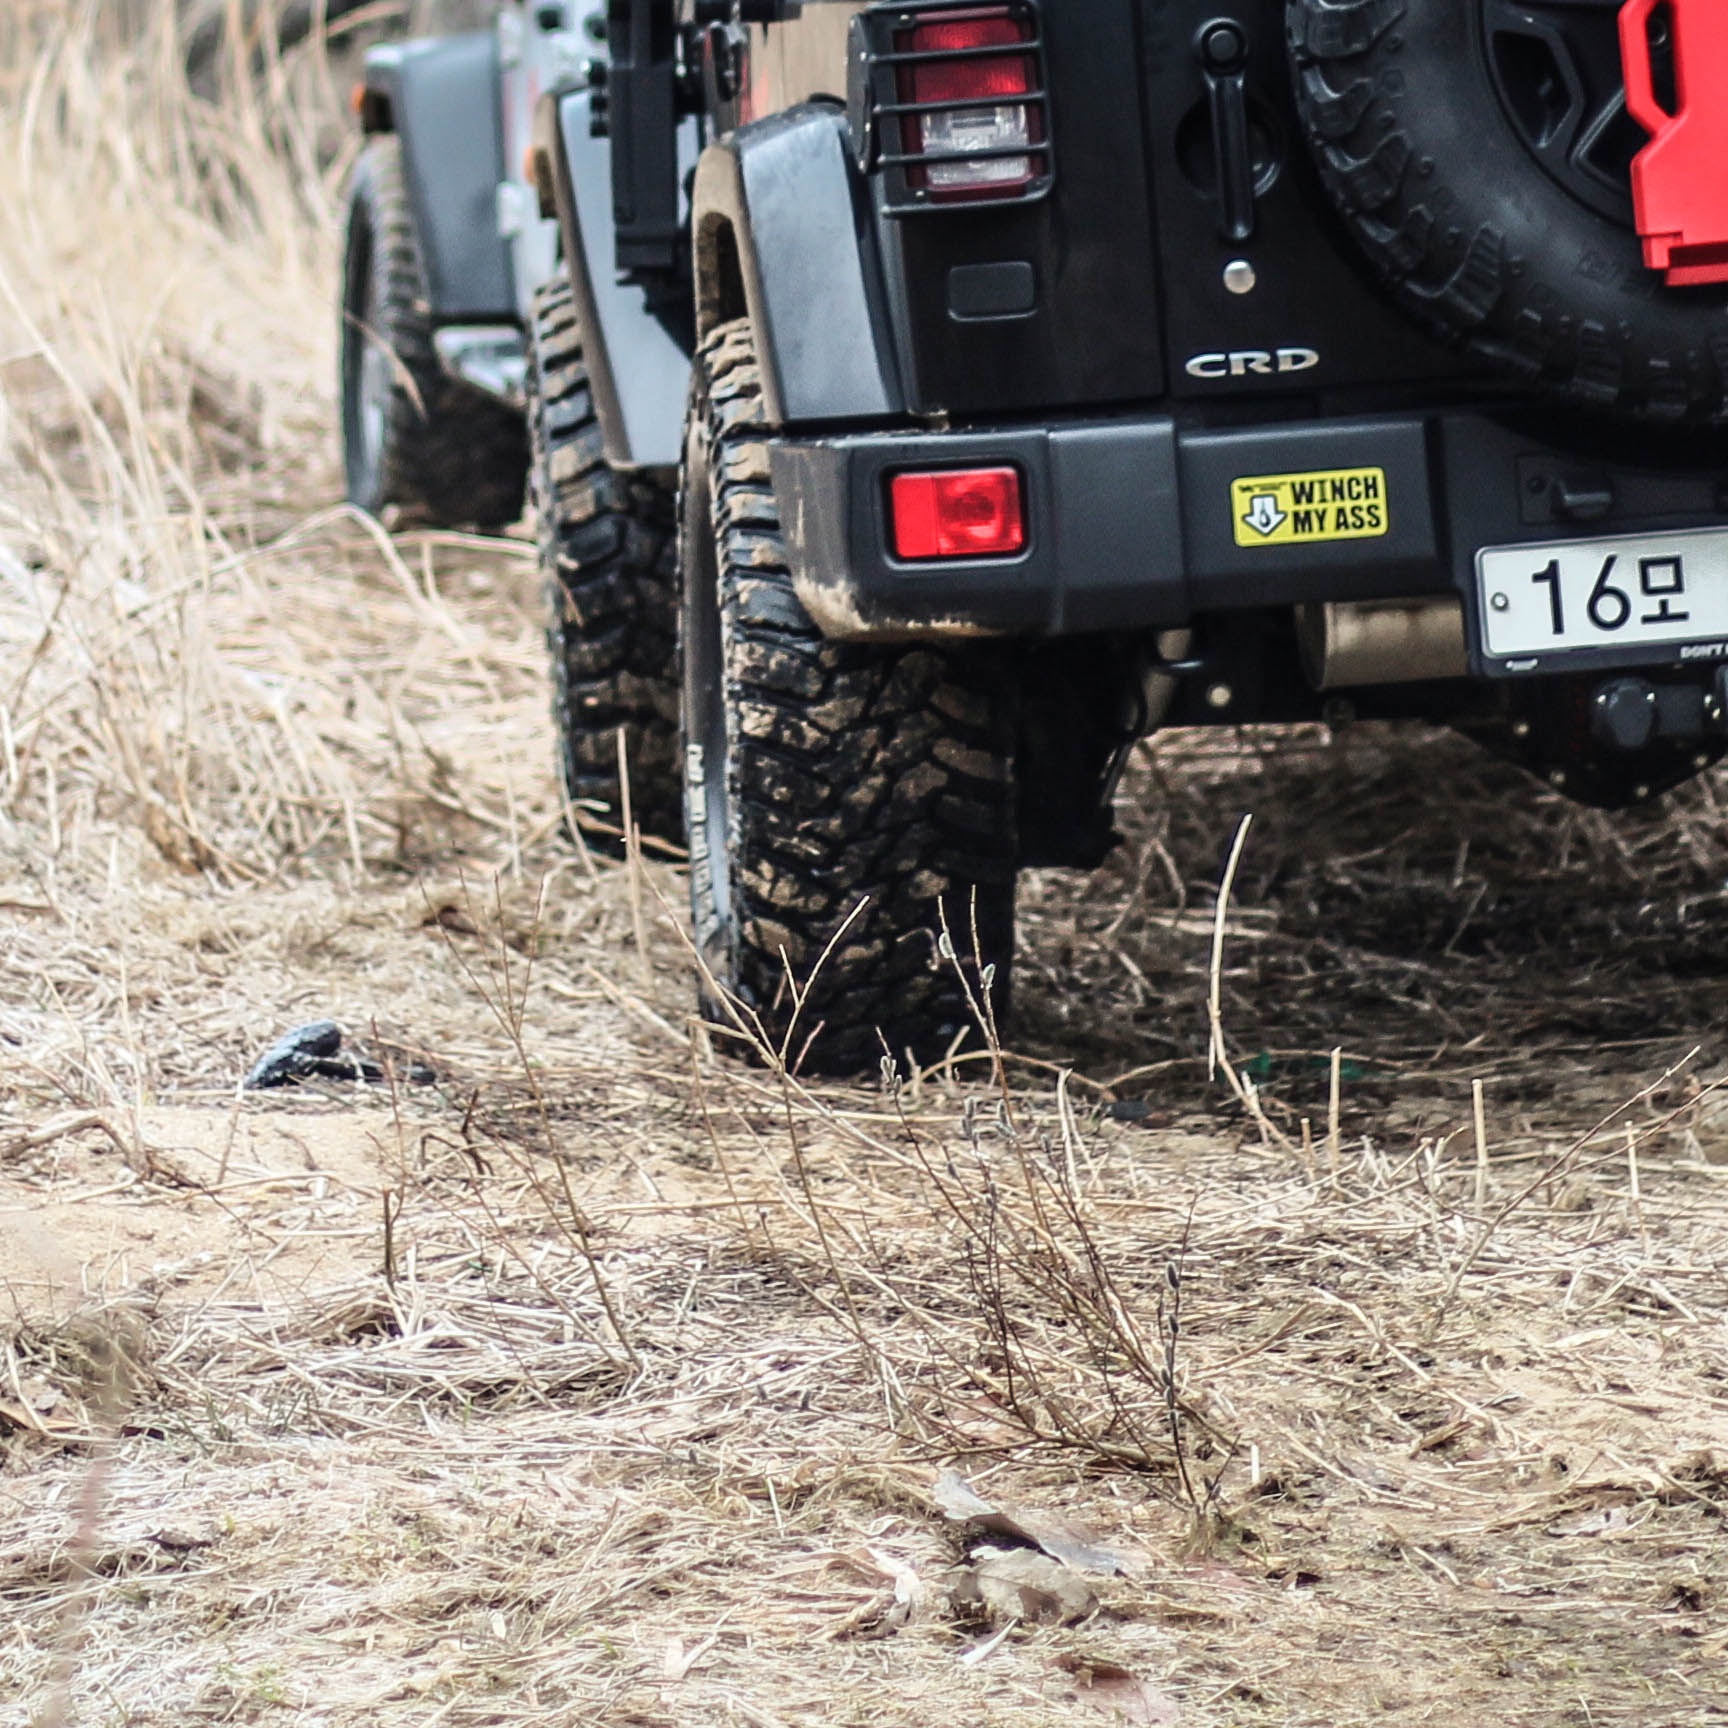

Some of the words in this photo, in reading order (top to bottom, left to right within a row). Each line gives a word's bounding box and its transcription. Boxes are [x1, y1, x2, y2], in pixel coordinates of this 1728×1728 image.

[1184, 347, 1320, 378] CRD
[1290, 476, 1379, 506] WINCH
[1292, 508, 1327, 535] MY
[1334, 504, 1381, 531] ASS
[1531, 553, 1690, 636] 16모
